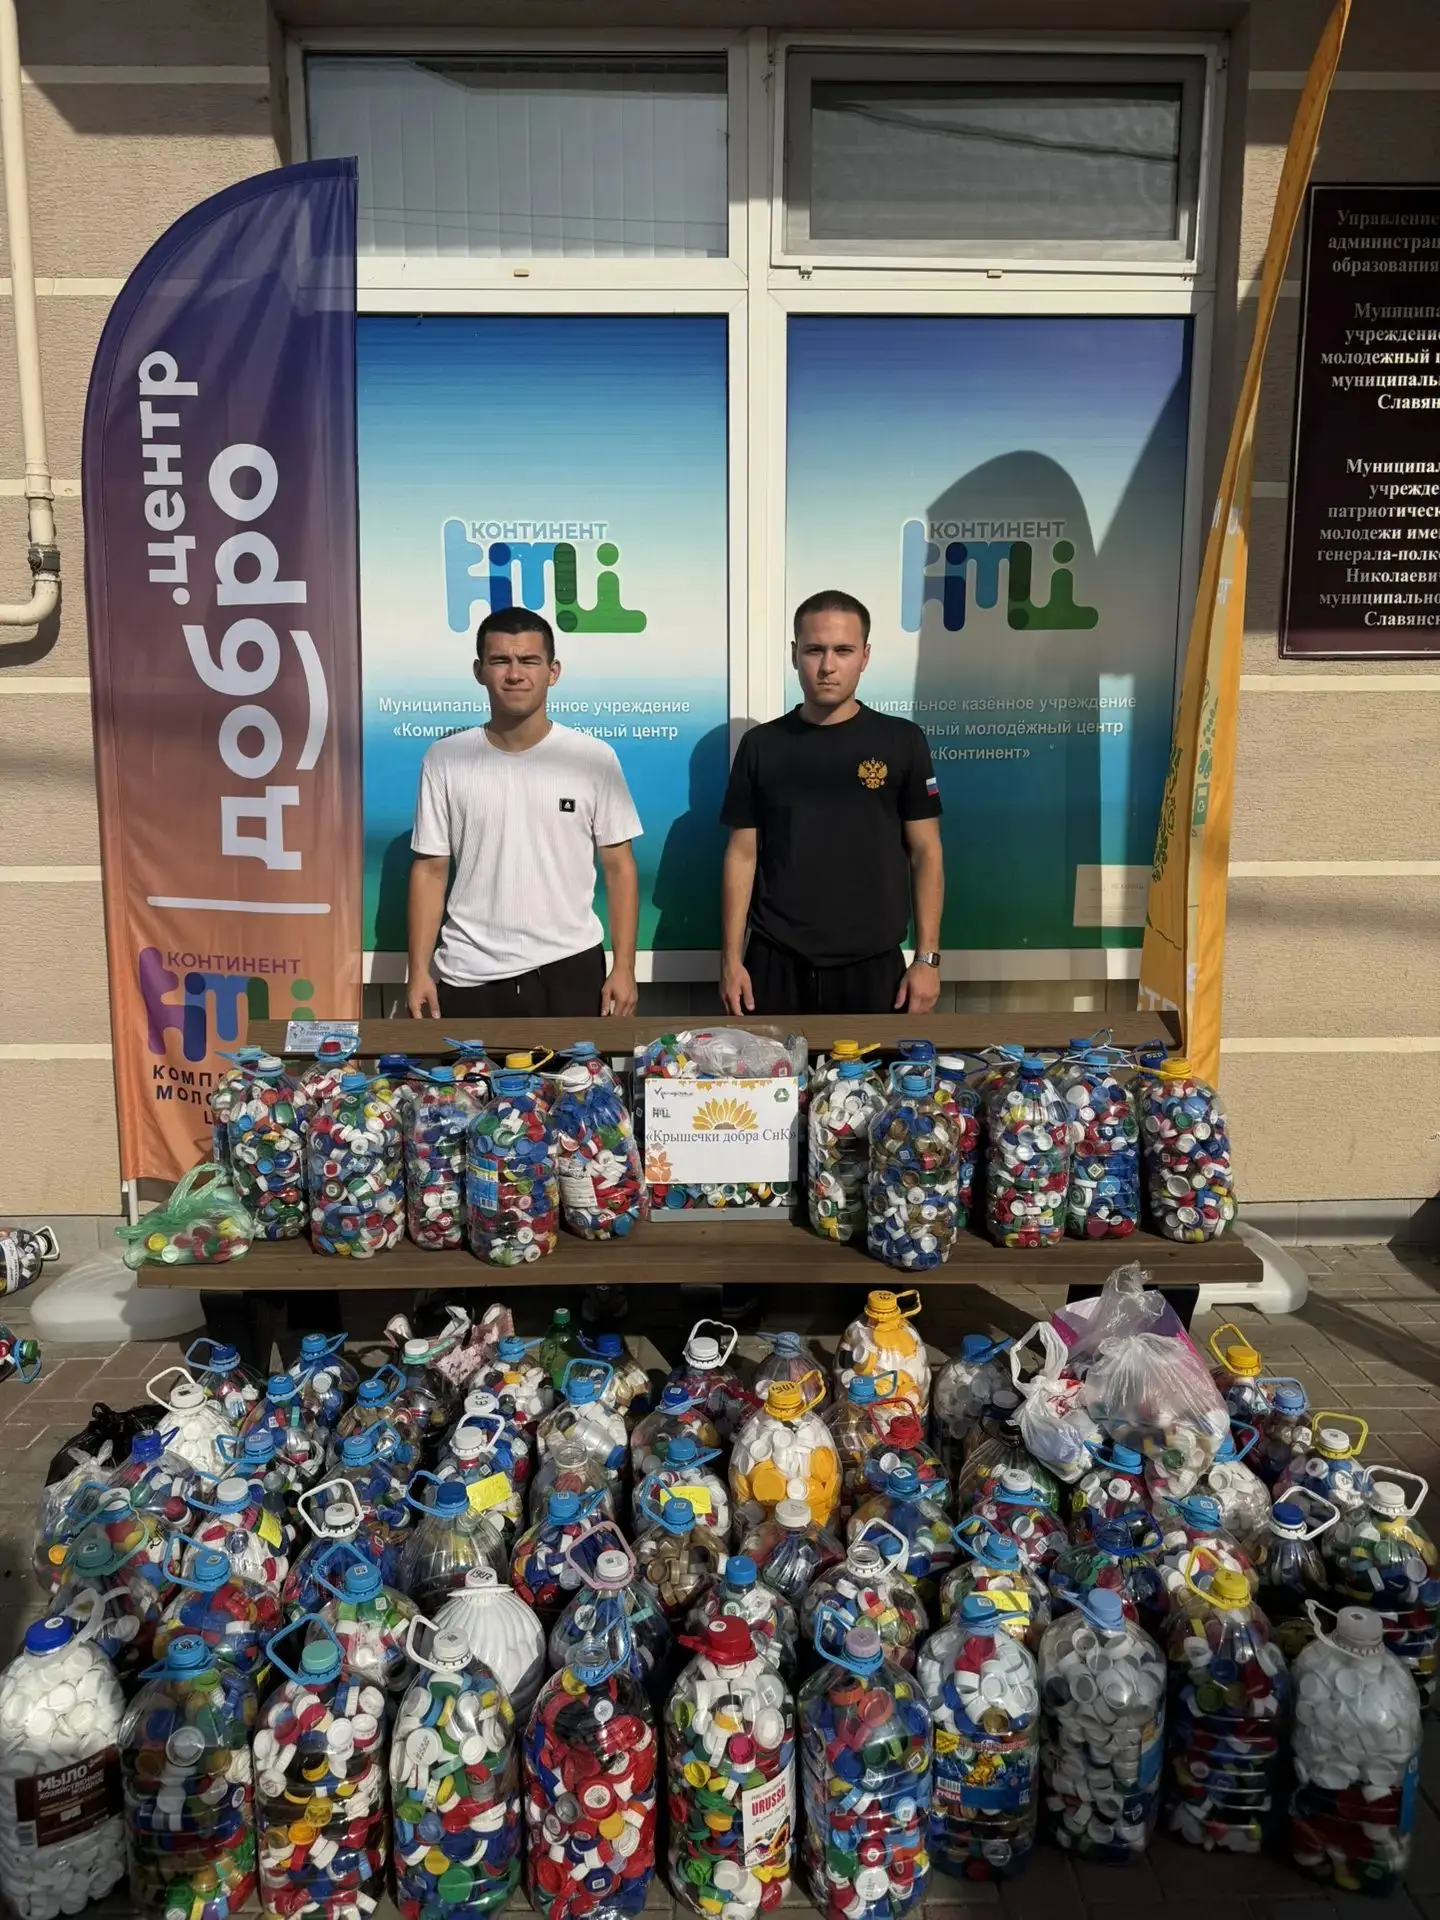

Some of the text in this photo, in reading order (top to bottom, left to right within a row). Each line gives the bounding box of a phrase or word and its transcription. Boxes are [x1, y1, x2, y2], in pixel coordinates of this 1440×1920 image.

[1337, 209, 1439, 228] Управление
[1332, 257, 1439, 276] образования
[1321, 349, 1430, 365] молодежный
[471, 522, 608, 540] КОНТИНЕНТ
[930, 520, 1066, 539] КОНТИНЕНТ
[1319, 529, 1440, 540] молодежи име
[379, 697, 491, 715] Муниципальн
[593, 701, 690, 716] учреждение
[866, 696, 1137, 713] ципальное казённое учреждение
[632, 727, 678, 740] центр
[965, 720, 1071, 736] молодёжный
[1077, 721, 1123, 736] центр
[930, 747, 1031, 760] «Континент»
[167, 951, 302, 975] КОНТИНЕНТ
[646, 1129, 719, 1145] «Крышечки
[723, 1128, 759, 1144] добра
